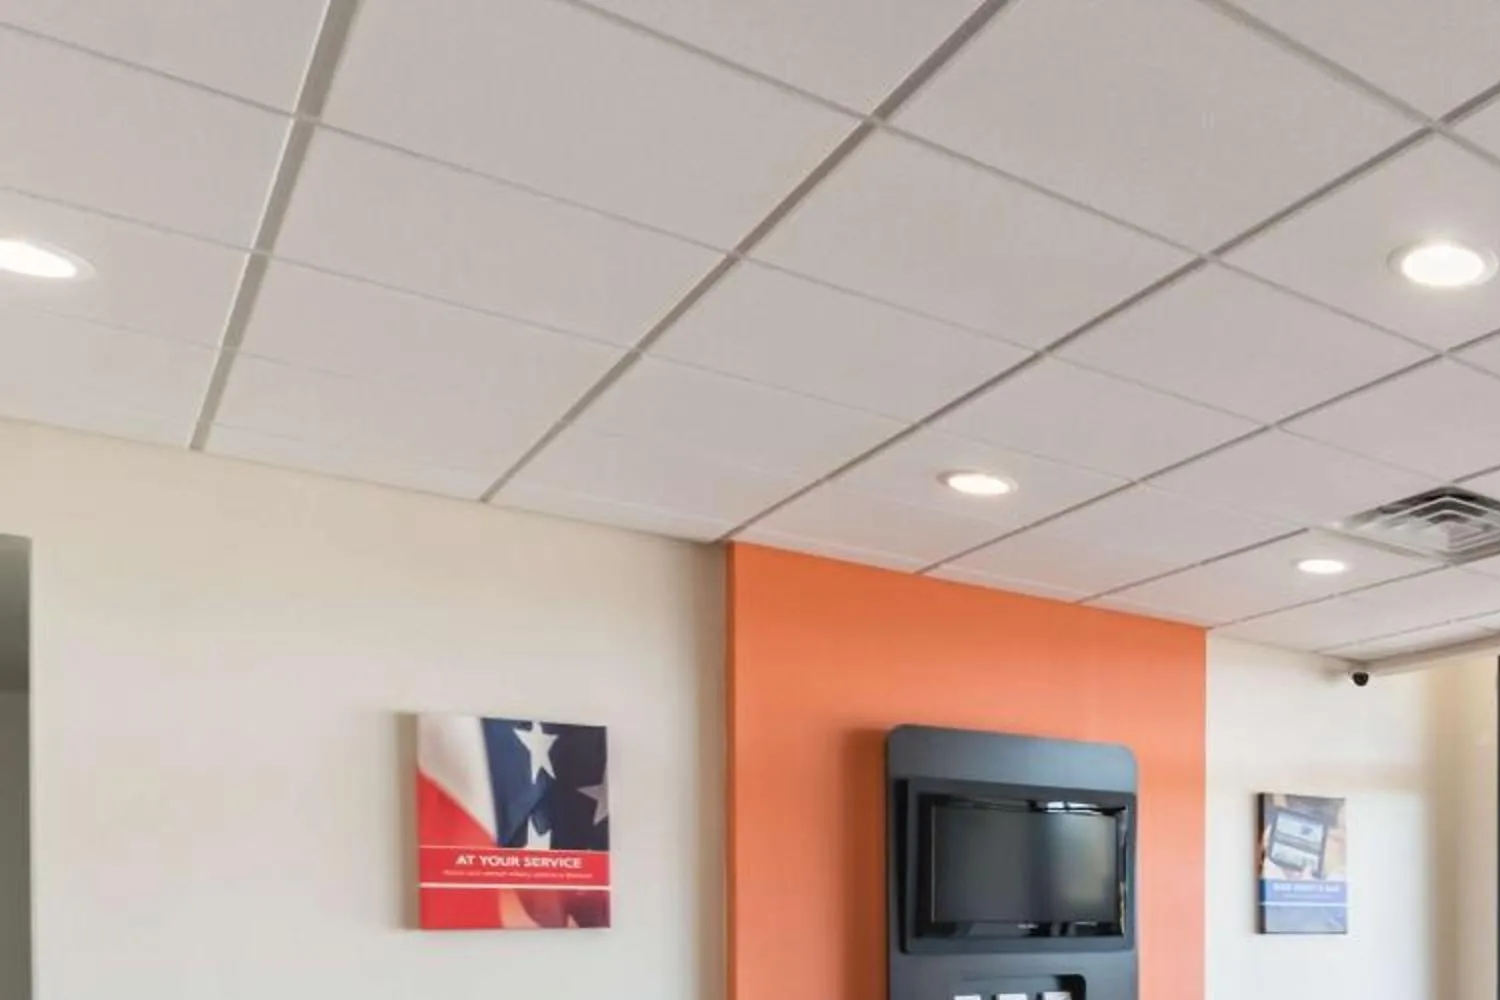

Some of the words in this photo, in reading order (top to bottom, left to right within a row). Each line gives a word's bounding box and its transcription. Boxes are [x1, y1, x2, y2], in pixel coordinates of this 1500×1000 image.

[455, 854, 475, 865] AT
[479, 855, 520, 867] YOUR
[523, 857, 582, 869] SERVICE
